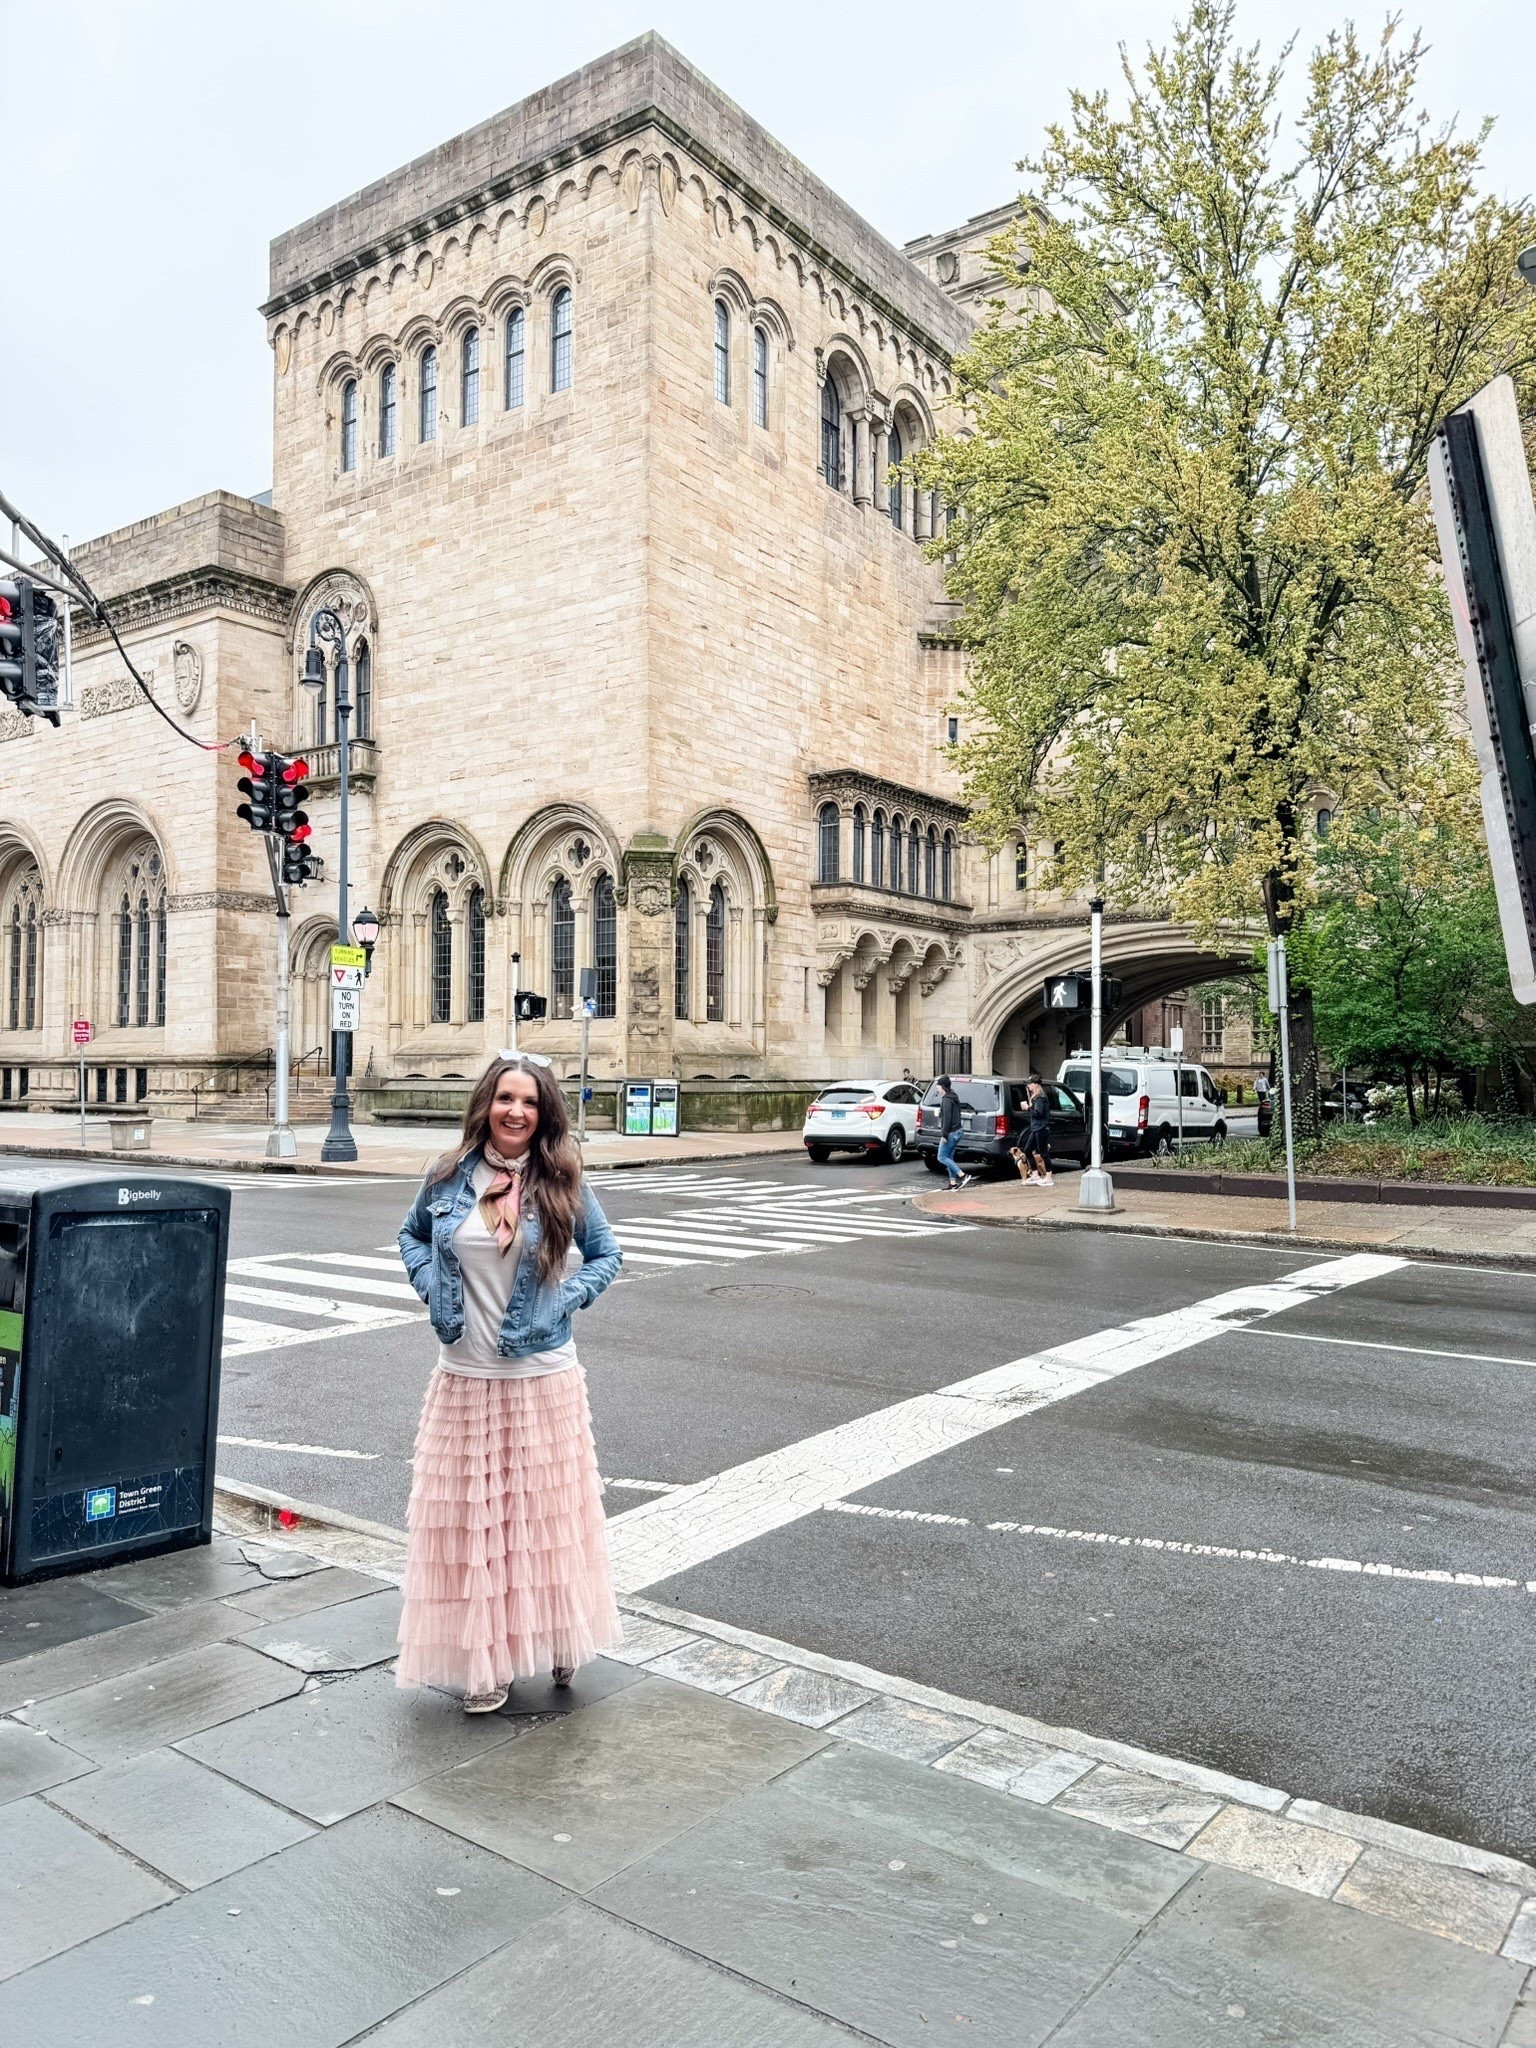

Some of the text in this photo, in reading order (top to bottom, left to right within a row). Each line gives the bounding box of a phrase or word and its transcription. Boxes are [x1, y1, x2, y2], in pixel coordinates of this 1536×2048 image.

[341, 991, 352, 1001] NO
[339, 1002, 354, 1010] TURN
[341, 1011, 351, 1019] ON
[339, 1020, 352, 1028] RED
[118, 1187, 162, 1205] Bigbelly
[119, 1485, 162, 1499] Town Green
[119, 1496, 146, 1508] District
